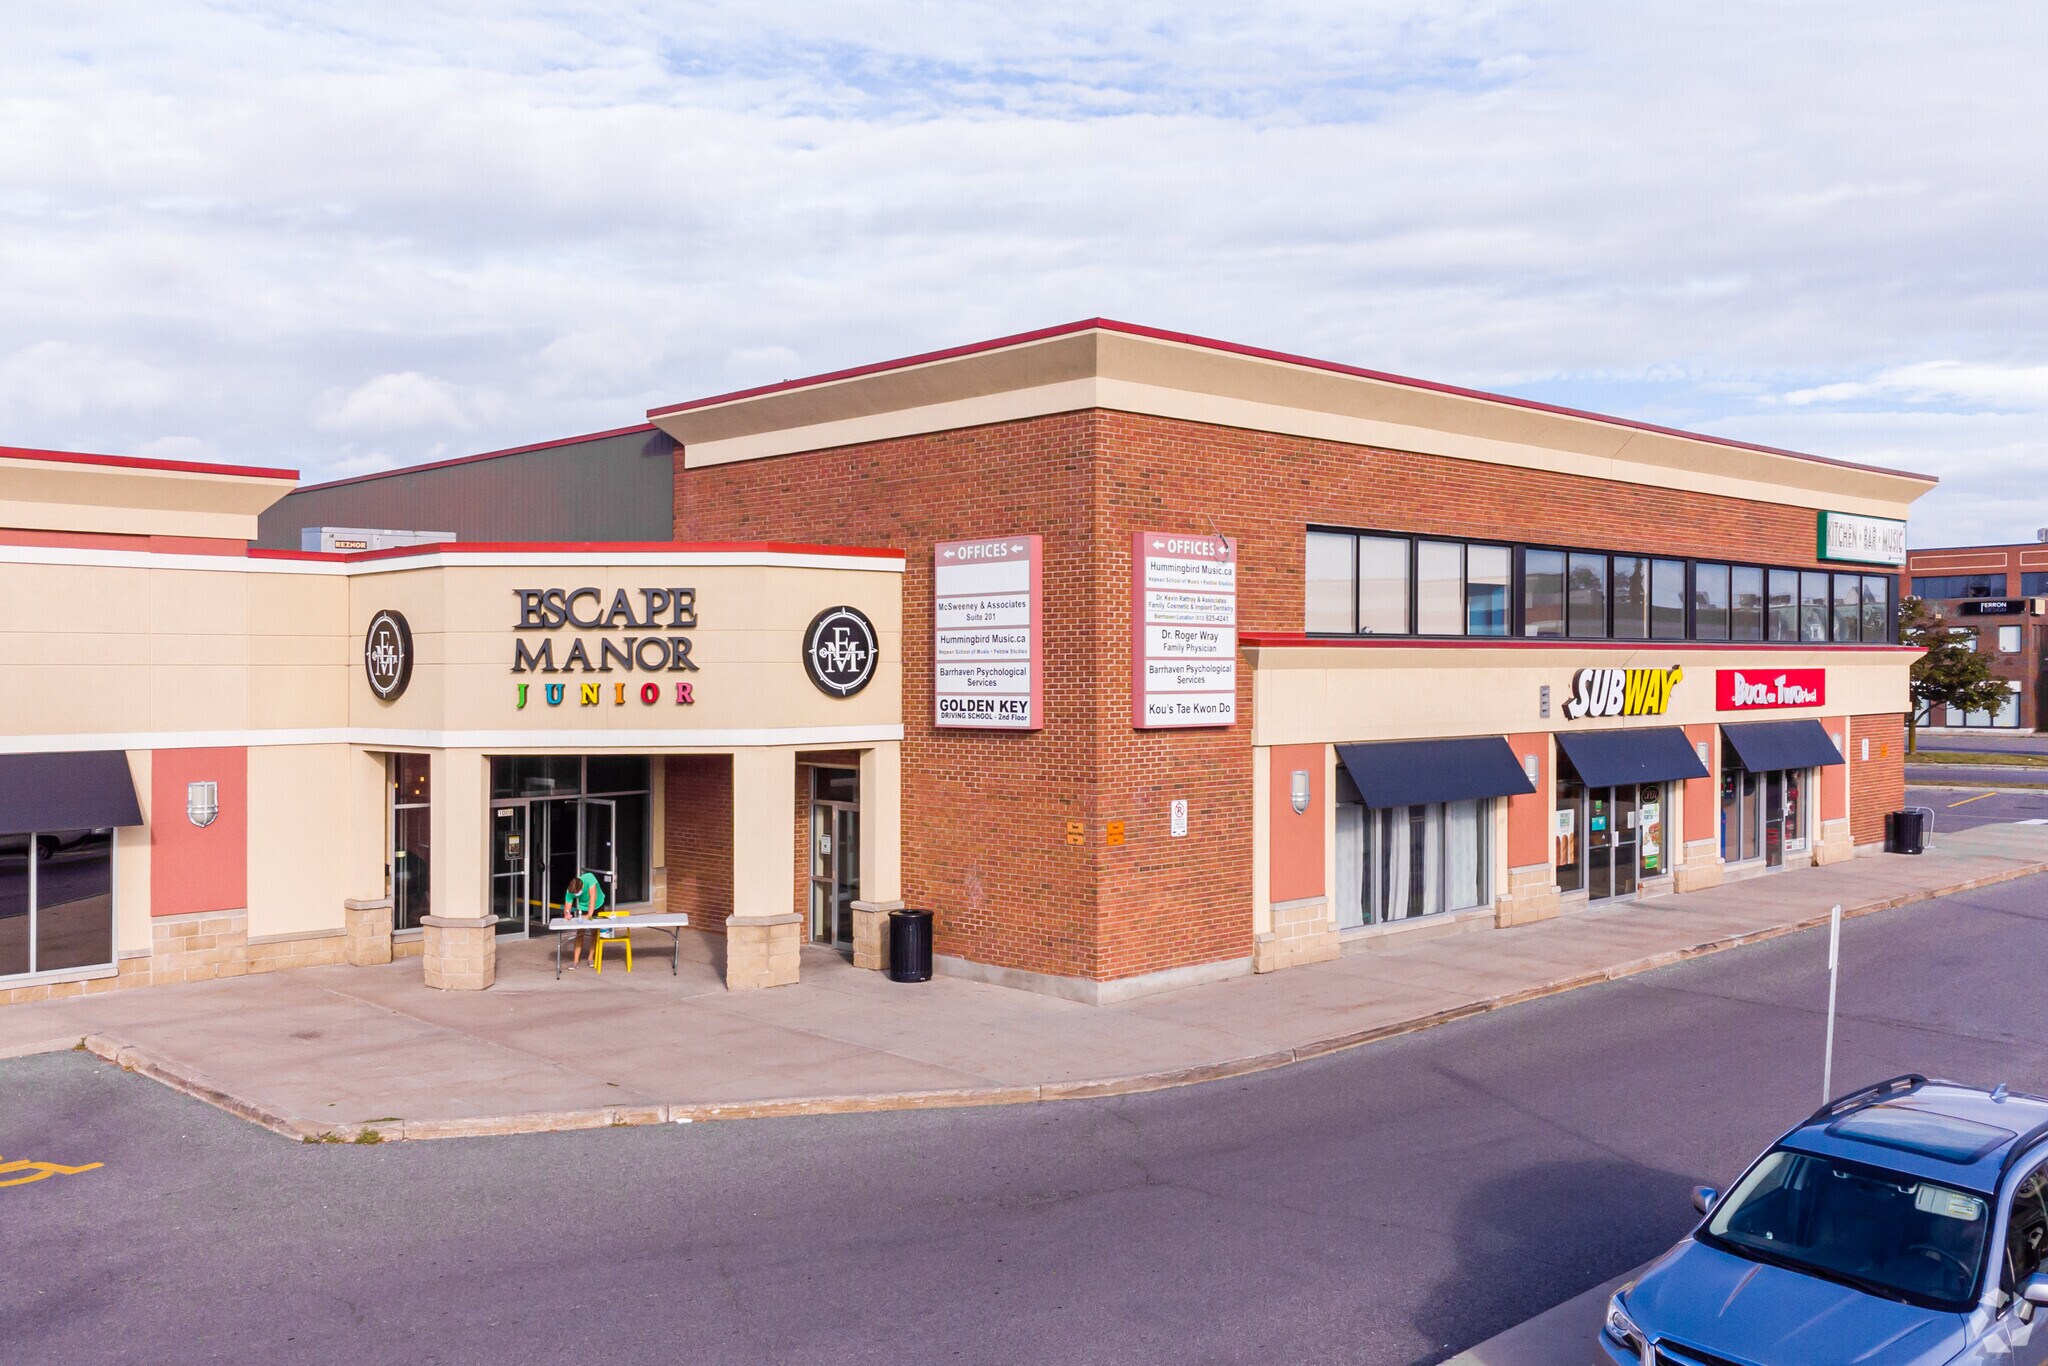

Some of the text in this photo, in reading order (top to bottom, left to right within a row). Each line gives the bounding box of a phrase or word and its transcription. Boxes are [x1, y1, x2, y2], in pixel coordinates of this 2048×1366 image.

[1828, 521, 1903, 553] KITCHEN BAR MUSIC
[958, 542, 1008, 560] OFFICES
[1168, 539, 1215, 556] OFFICES
[1150, 561, 1232, 575] Hummingbird Music.ca
[512, 587, 698, 630] ESCAPE
[938, 600, 1026, 612] McSweeney & Associates
[1980, 602, 2007, 612] FERRON
[966, 613, 996, 621] Suite 201
[940, 634, 1026, 646] Hummingbird Music.ca
[1162, 629, 1218, 643] Dr. Roger Wray
[510, 636, 700, 672] MANOR
[1163, 643, 1217, 653] Family Physician
[940, 667, 1026, 678] Barrhaven Psychological
[1149, 664, 1232, 674] Barrhaven Psychological
[967, 678, 997, 687] Services
[1176, 676, 1205, 684] Services
[516, 682, 694, 709] JUNIOR
[1564, 665, 1683, 720] SUBWAY
[940, 699, 1028, 713] GOLDEN KEY
[1149, 702, 1230, 714] Kou's Tae Kwon Do
